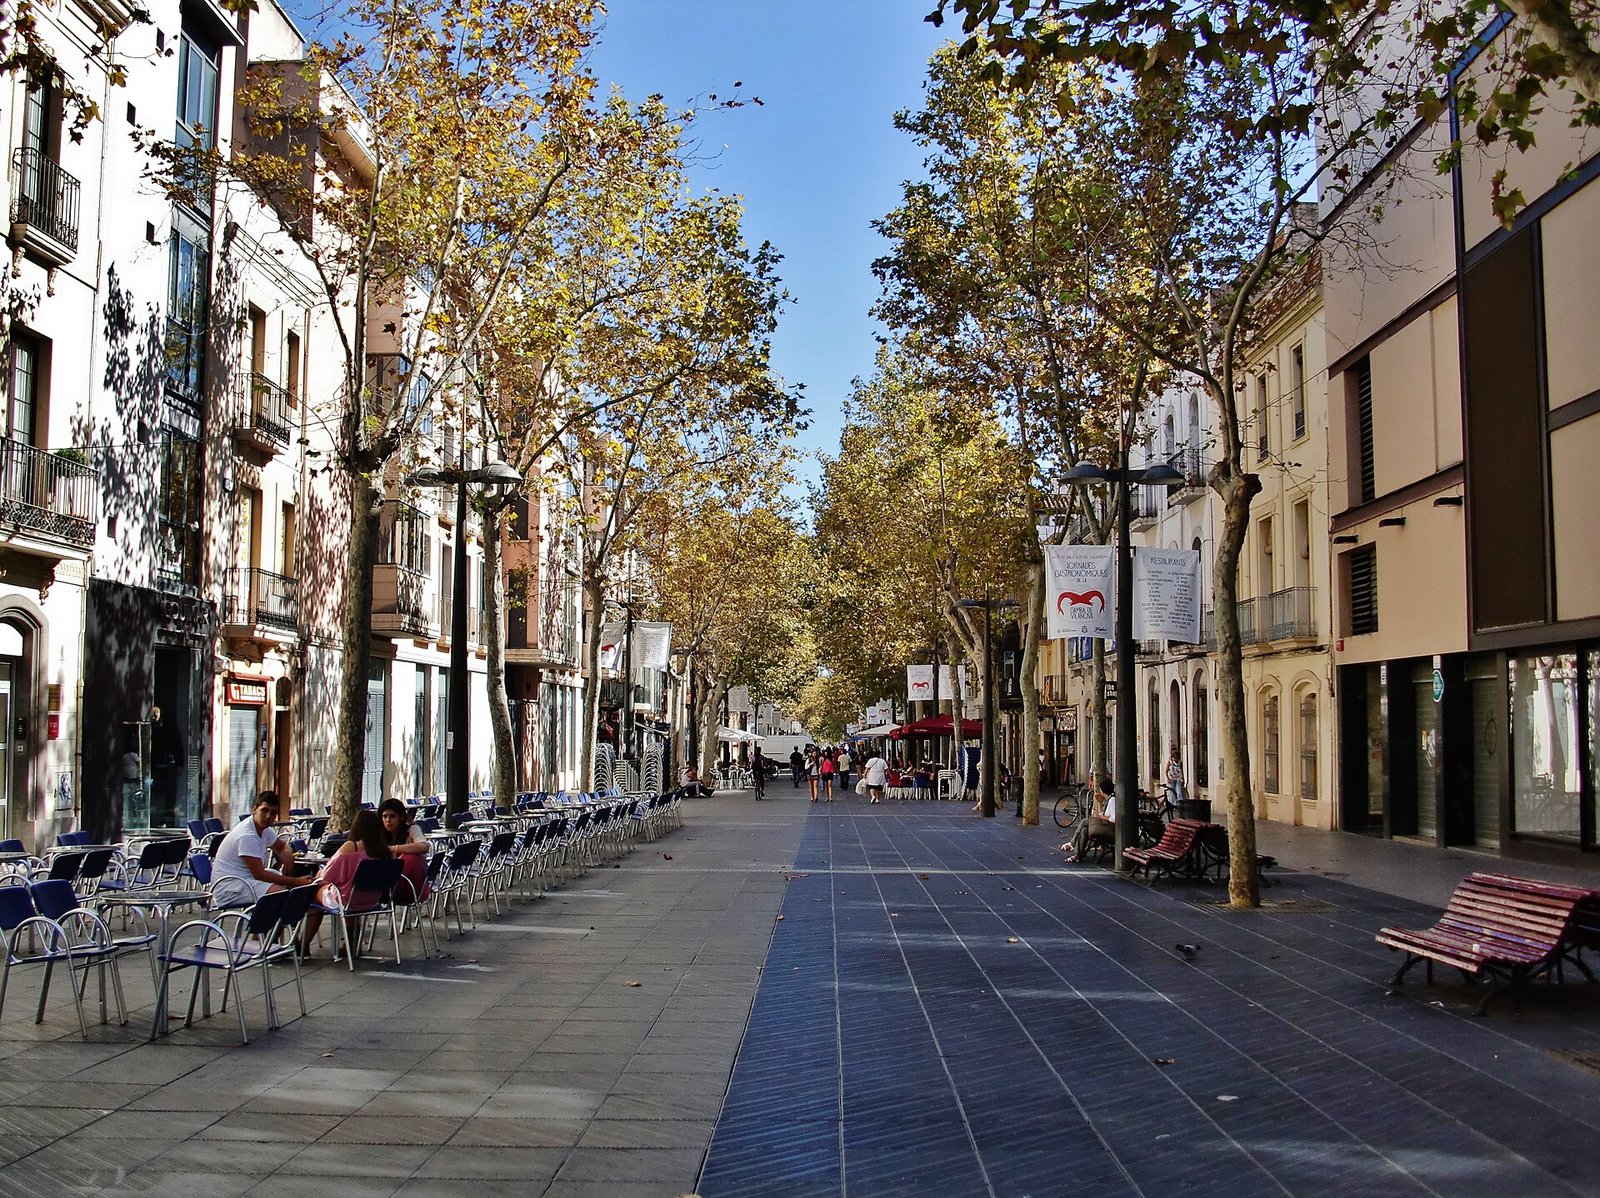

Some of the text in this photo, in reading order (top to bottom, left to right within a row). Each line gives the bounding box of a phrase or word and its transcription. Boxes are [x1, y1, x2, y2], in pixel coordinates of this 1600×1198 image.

[1066, 561, 1096, 570] JORNADES
[1150, 556, 1187, 567] RESTAURANTS
[1071, 612, 1094, 620] VILANOVA
[239, 684, 266, 697] TABACS
